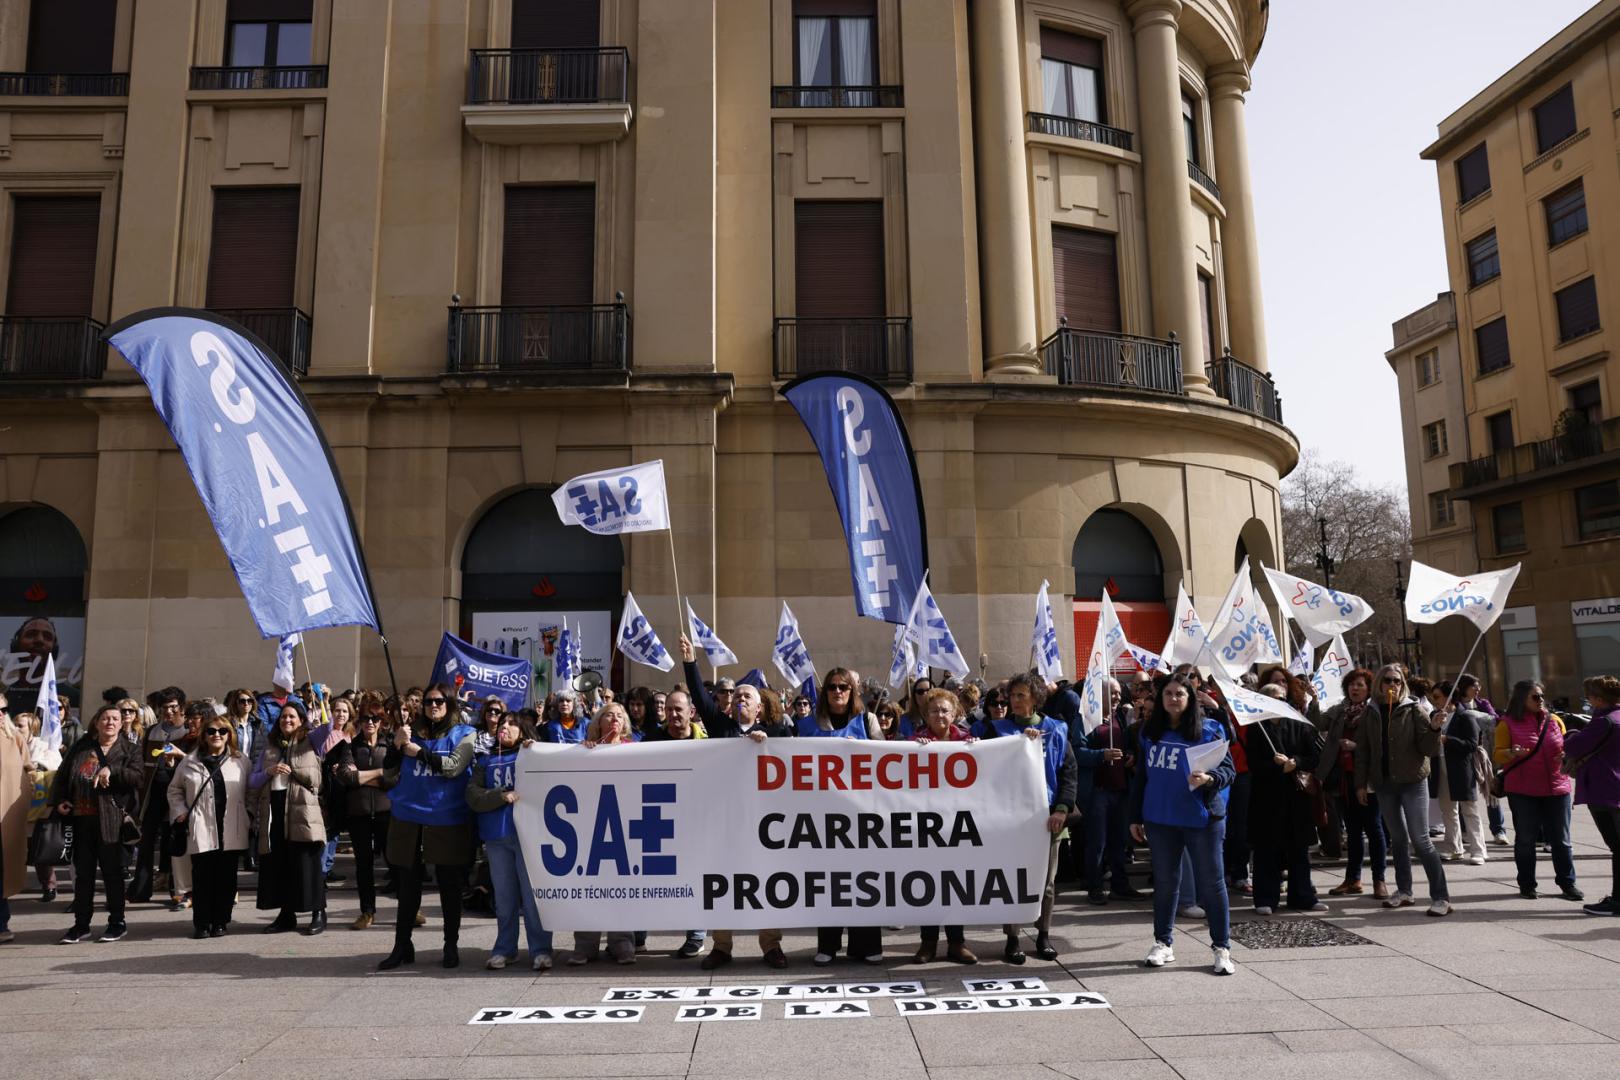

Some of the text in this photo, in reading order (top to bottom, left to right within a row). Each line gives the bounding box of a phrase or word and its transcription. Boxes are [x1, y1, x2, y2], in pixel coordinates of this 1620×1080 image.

[757, 752, 978, 791] DERECHO
[758, 810, 983, 850] CARRERA
[571, 888, 582, 899] DE
[585, 885, 627, 899] TÉCNICOS
[629, 888, 640, 899] DE
[642, 884, 694, 899] ENFERMERÍA
[703, 868, 1040, 910] PROFESIONAL
[607, 980, 1041, 1000] EXIGIMOS EL
[476, 994, 1107, 1021] PAGO DE LA DEUDA
